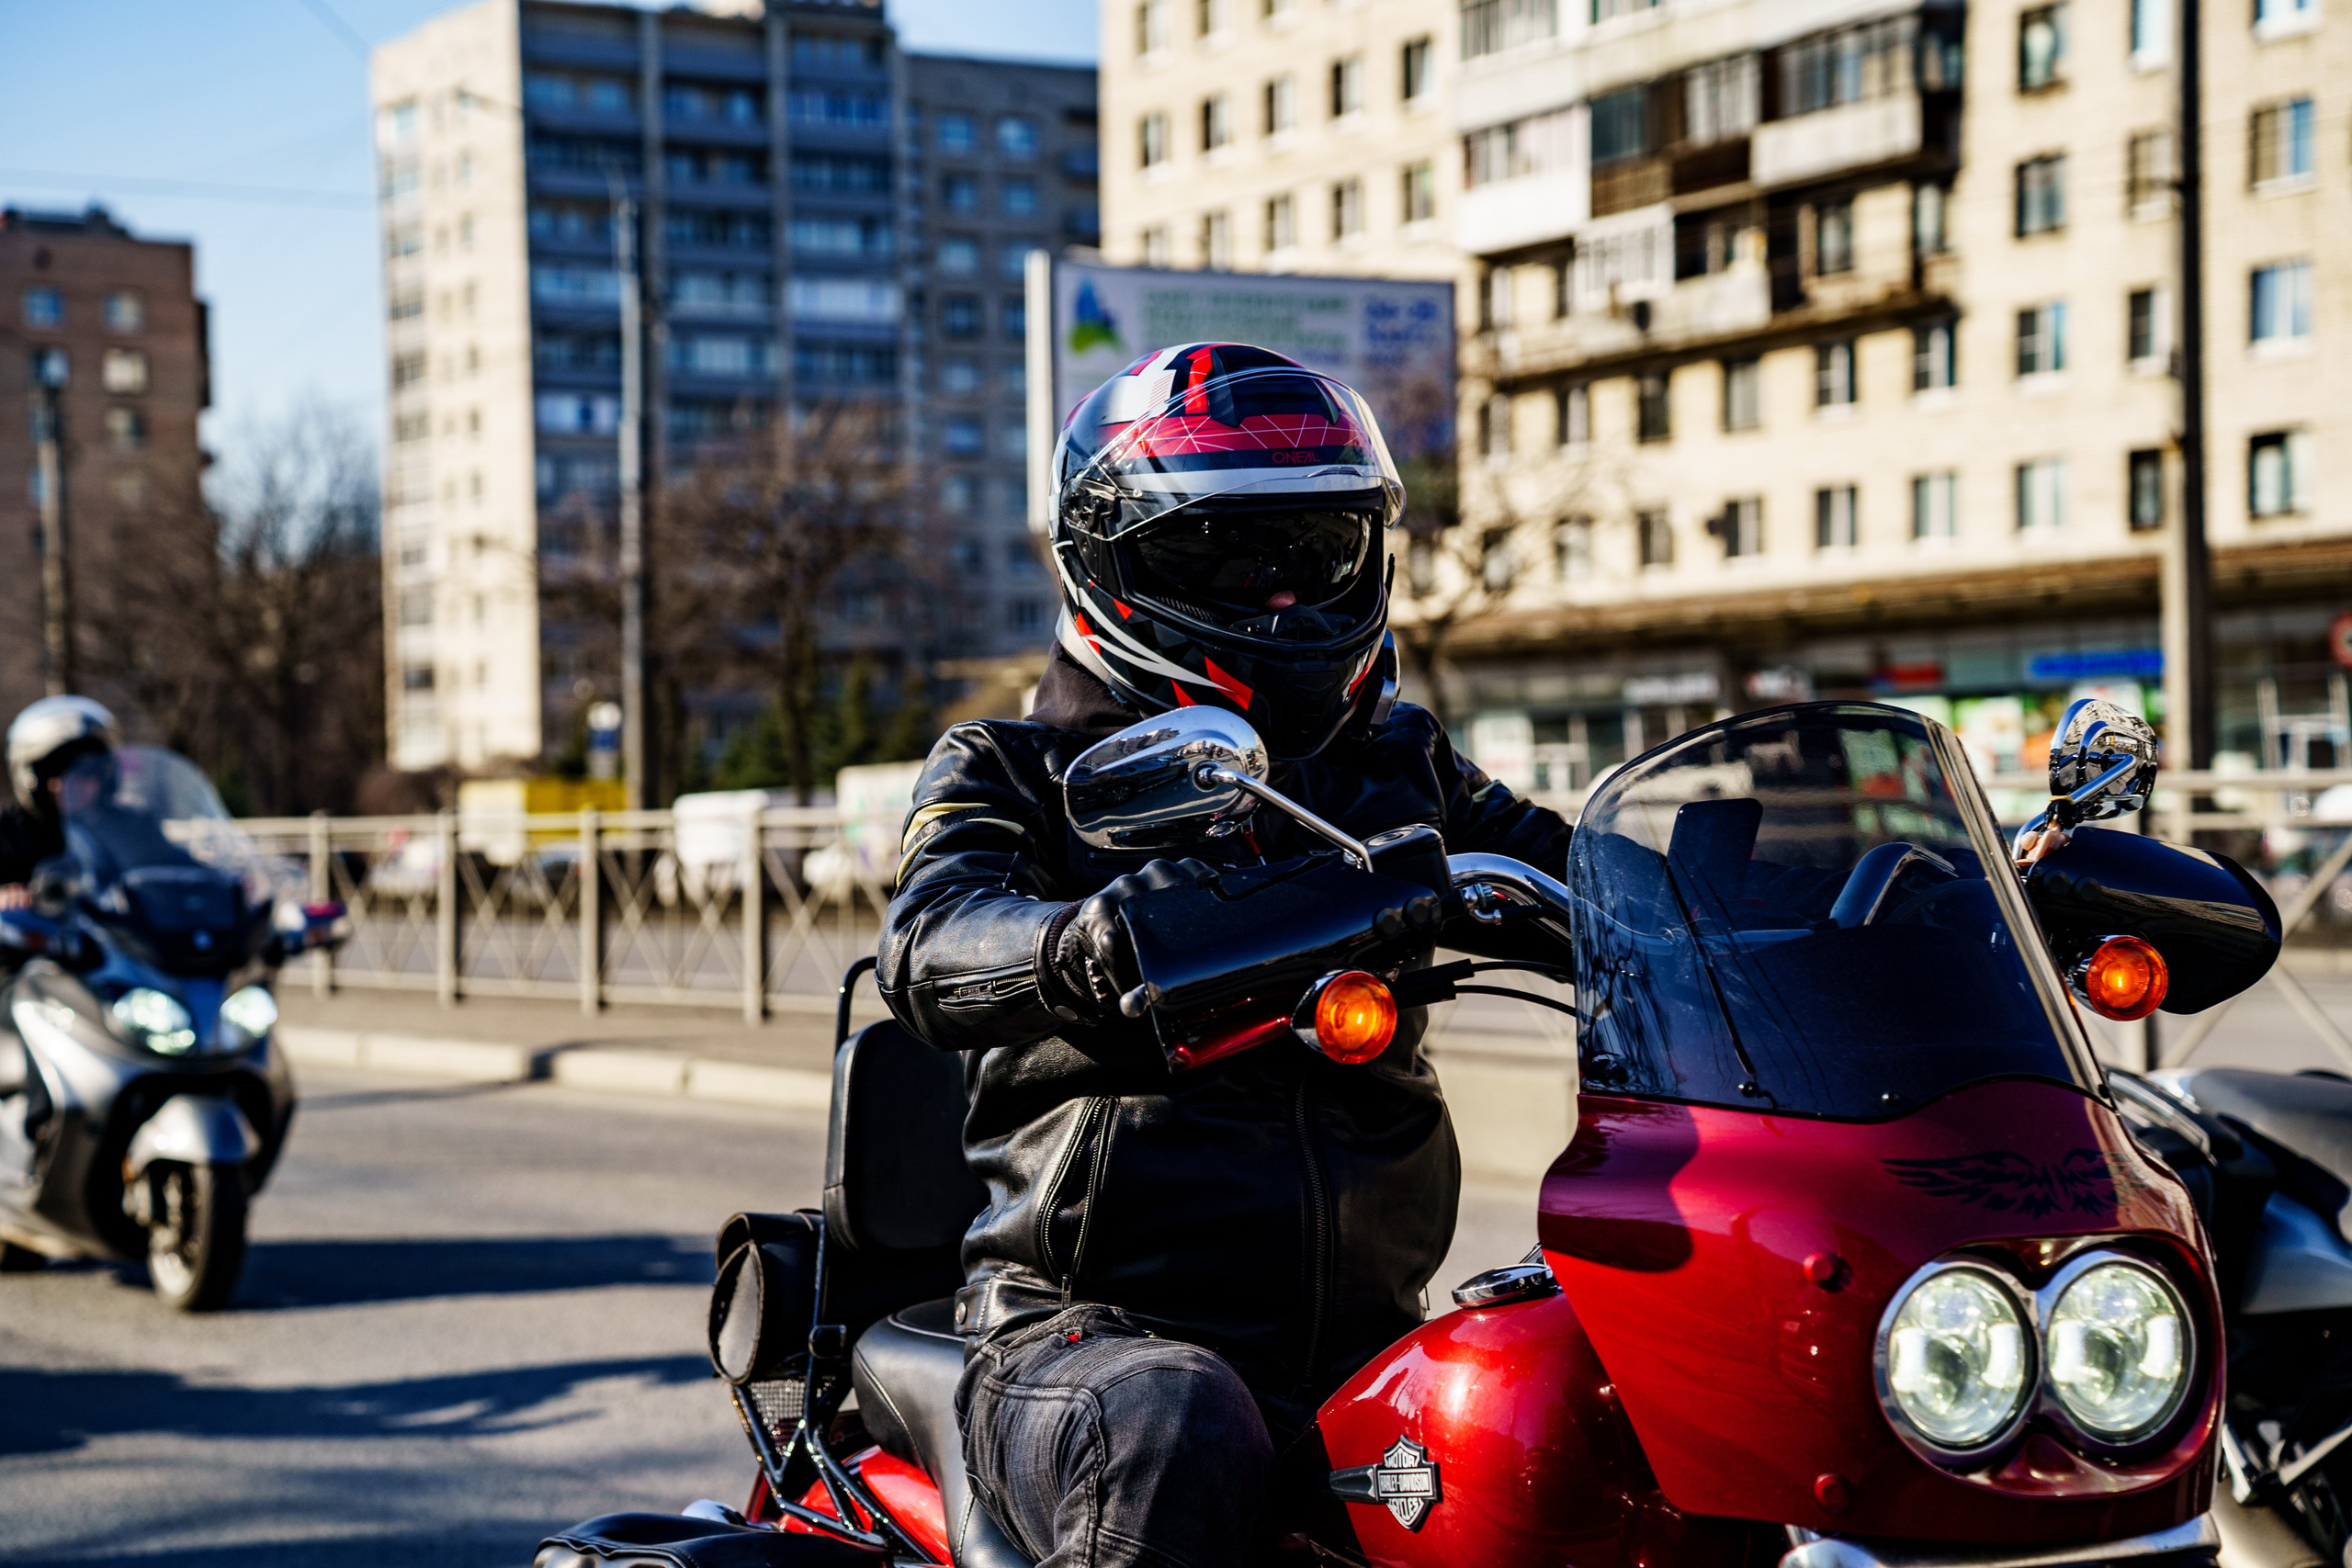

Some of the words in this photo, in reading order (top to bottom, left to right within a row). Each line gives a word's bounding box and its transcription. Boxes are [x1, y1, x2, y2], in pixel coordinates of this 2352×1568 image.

[1272, 450, 1321, 464] ONEAL
[1386, 1449, 1415, 1468] MOTOR
[1379, 1473, 1430, 1492] HARLEY-DAVIDSON
[1390, 1497, 1419, 1520] CYCLES
